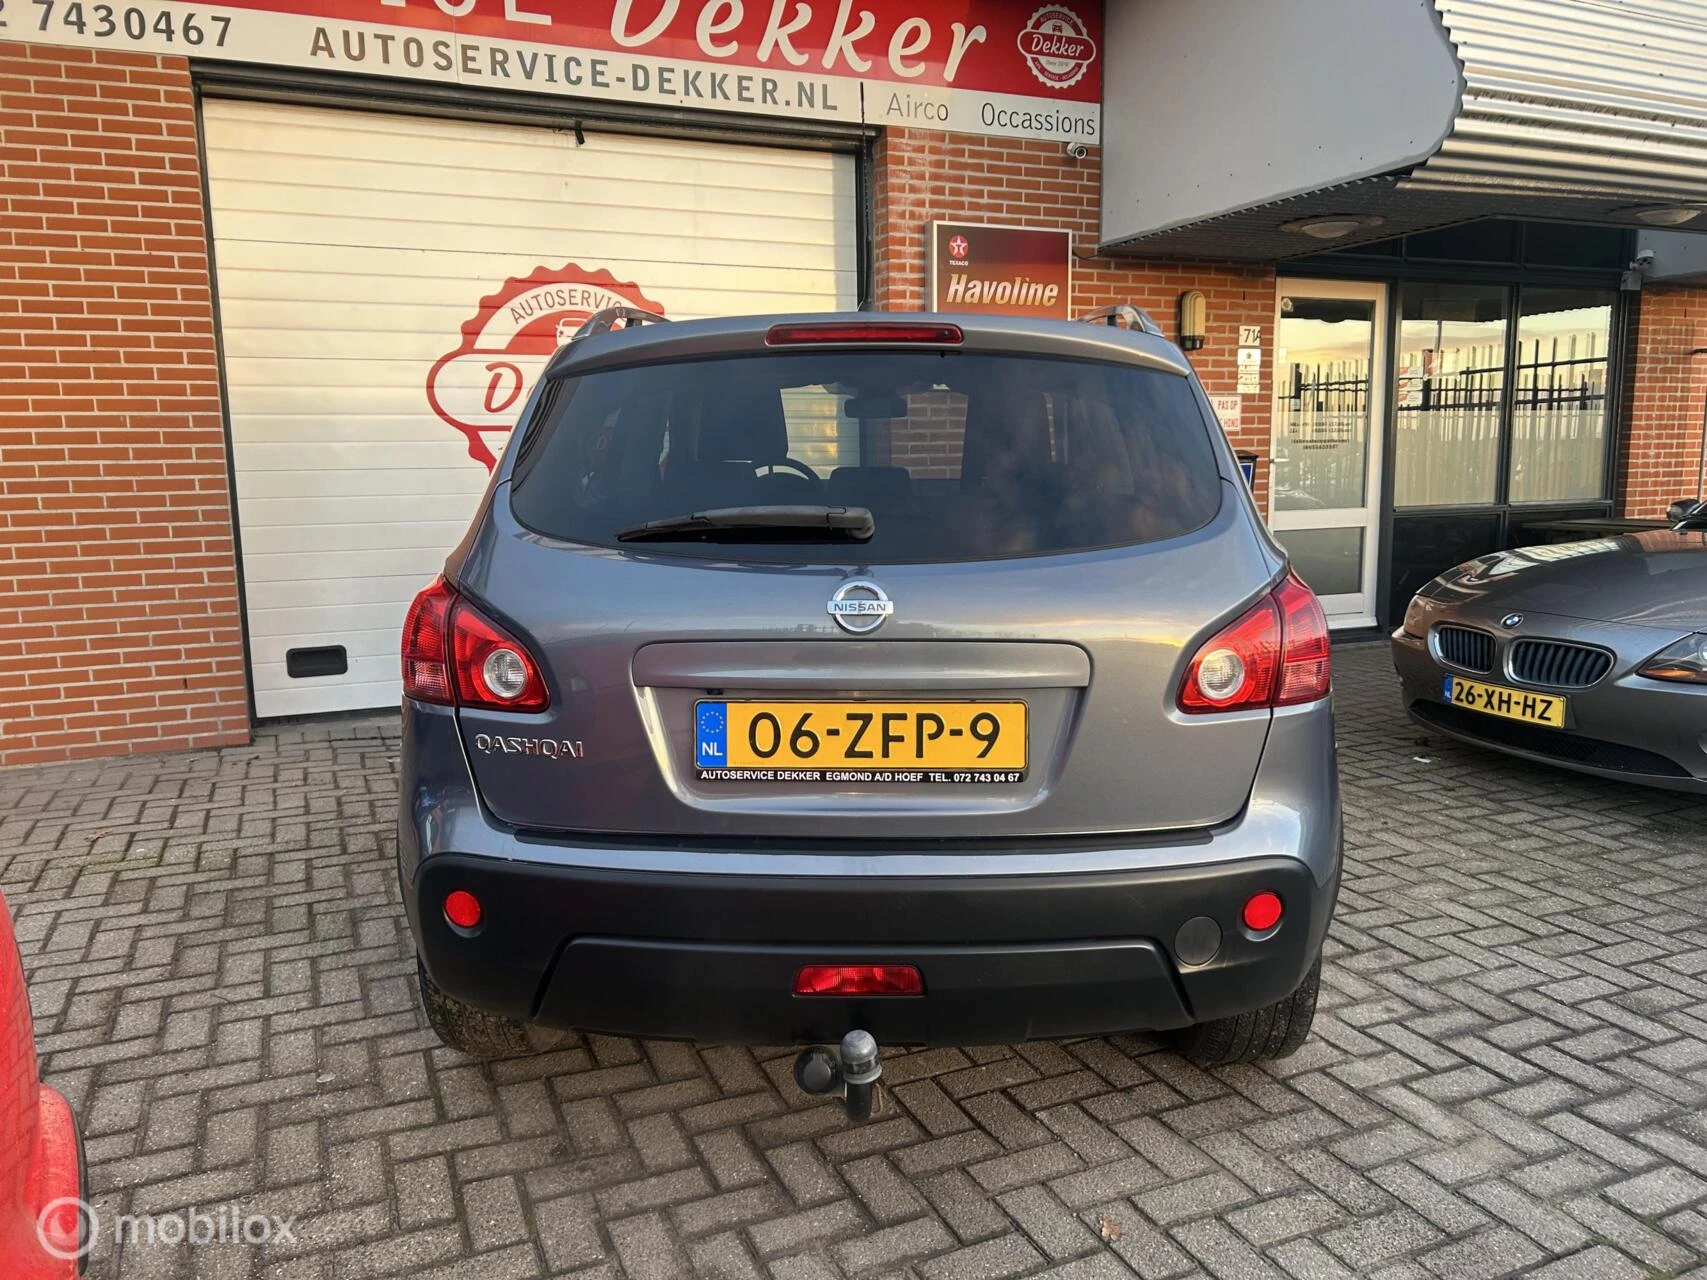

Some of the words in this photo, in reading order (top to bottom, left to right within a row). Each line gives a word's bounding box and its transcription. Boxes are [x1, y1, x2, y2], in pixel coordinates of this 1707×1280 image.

[32, 0, 233, 47] 7430467
[1031, 33, 1085, 57] Dekker
[310, 26, 839, 112] AUTOSERVICE-DEKKER.NL
[886, 92, 950, 122] Airco
[981, 102, 1096, 136] Occassions
[946, 273, 1059, 307] Havoline
[834, 603, 886, 612] NISSAN
[1454, 681, 1553, 721] 26-XH-HZ
[475, 733, 585, 760] QASHQAI
[701, 742, 723, 756] NL
[748, 711, 1001, 760] 06-ZFP-9
[700, 770, 775, 780] AUTOSERVICE
[777, 770, 820, 780] DEKKER
[826, 771, 874, 781] EGMOND
[874, 772, 892, 782] A/D
[894, 773, 923, 782] HOEF
[929, 773, 951, 782] TEL.
[953, 773, 971, 782] 072
[973, 773, 991, 782] 743
[993, 773, 1006, 782] 04
[1007, 773, 1020, 782] 67
